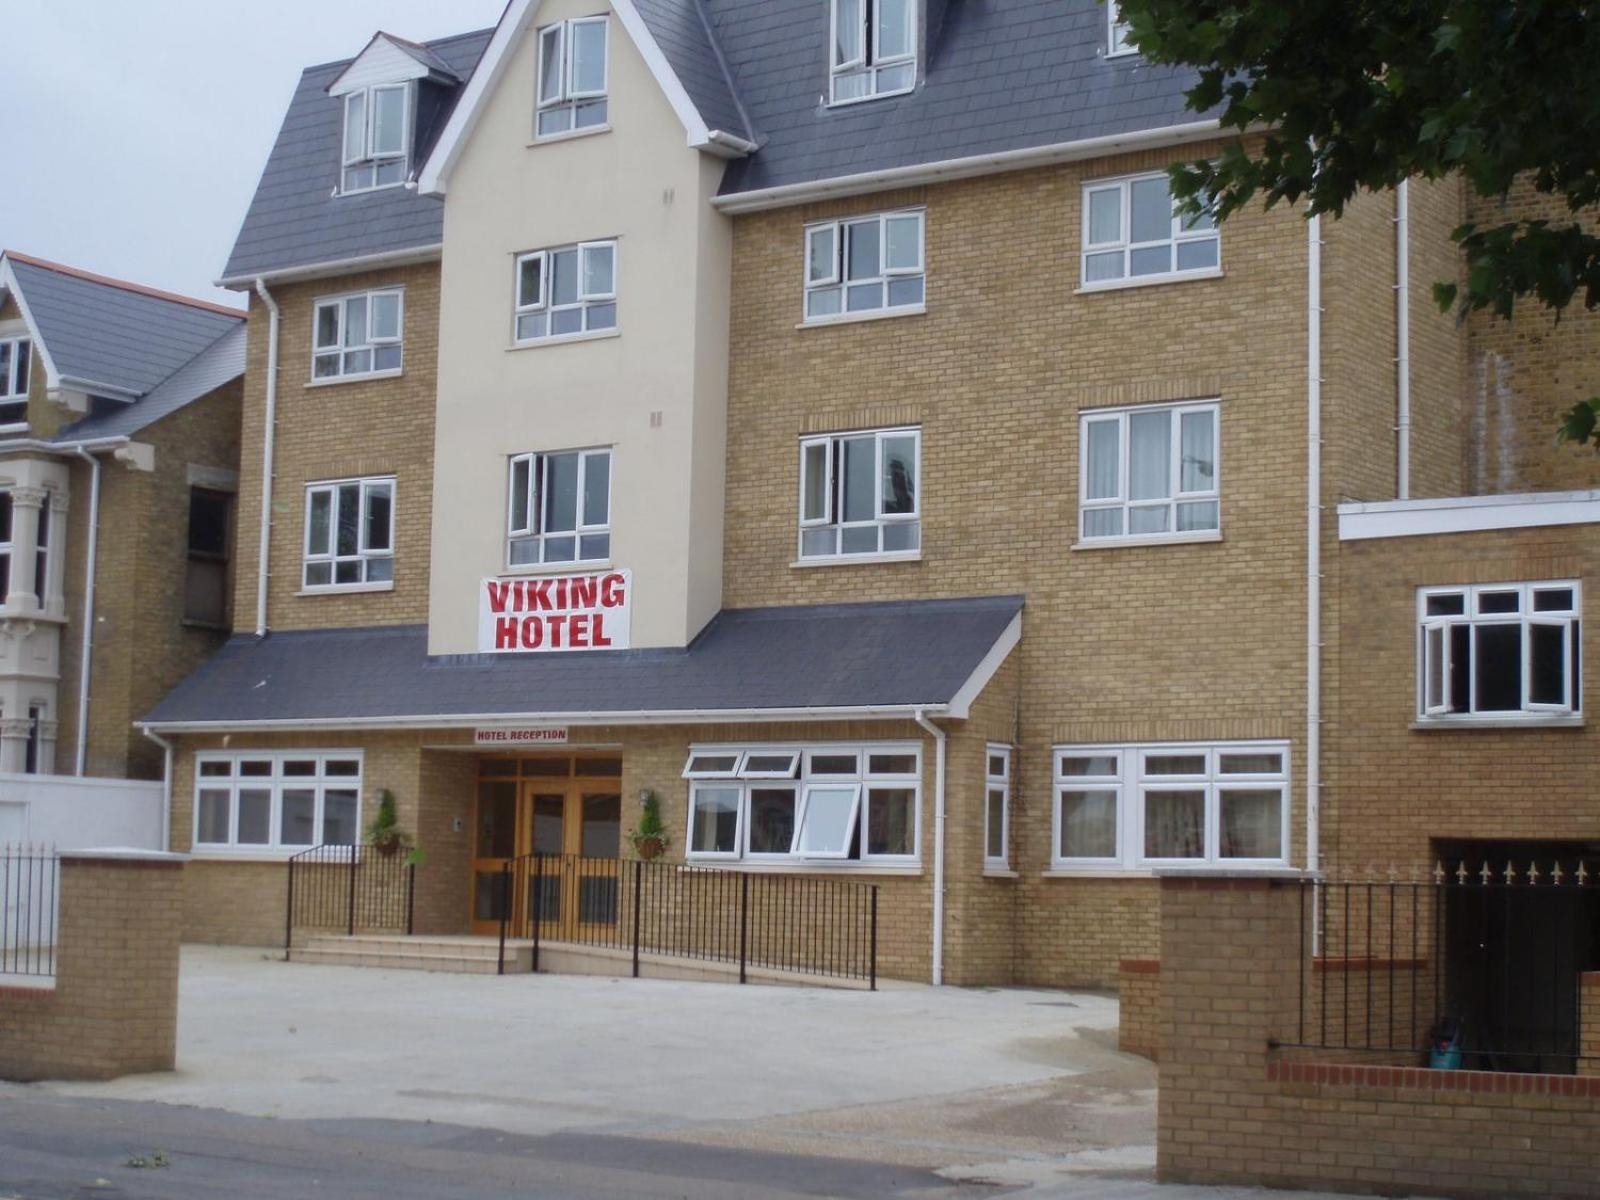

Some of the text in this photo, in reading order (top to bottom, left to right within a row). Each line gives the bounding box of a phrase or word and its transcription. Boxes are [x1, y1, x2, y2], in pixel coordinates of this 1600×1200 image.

[488, 574, 625, 613] VIKING
[496, 614, 612, 649] HOTEL
[478, 729, 566, 740] HOTEL RECEPTION
